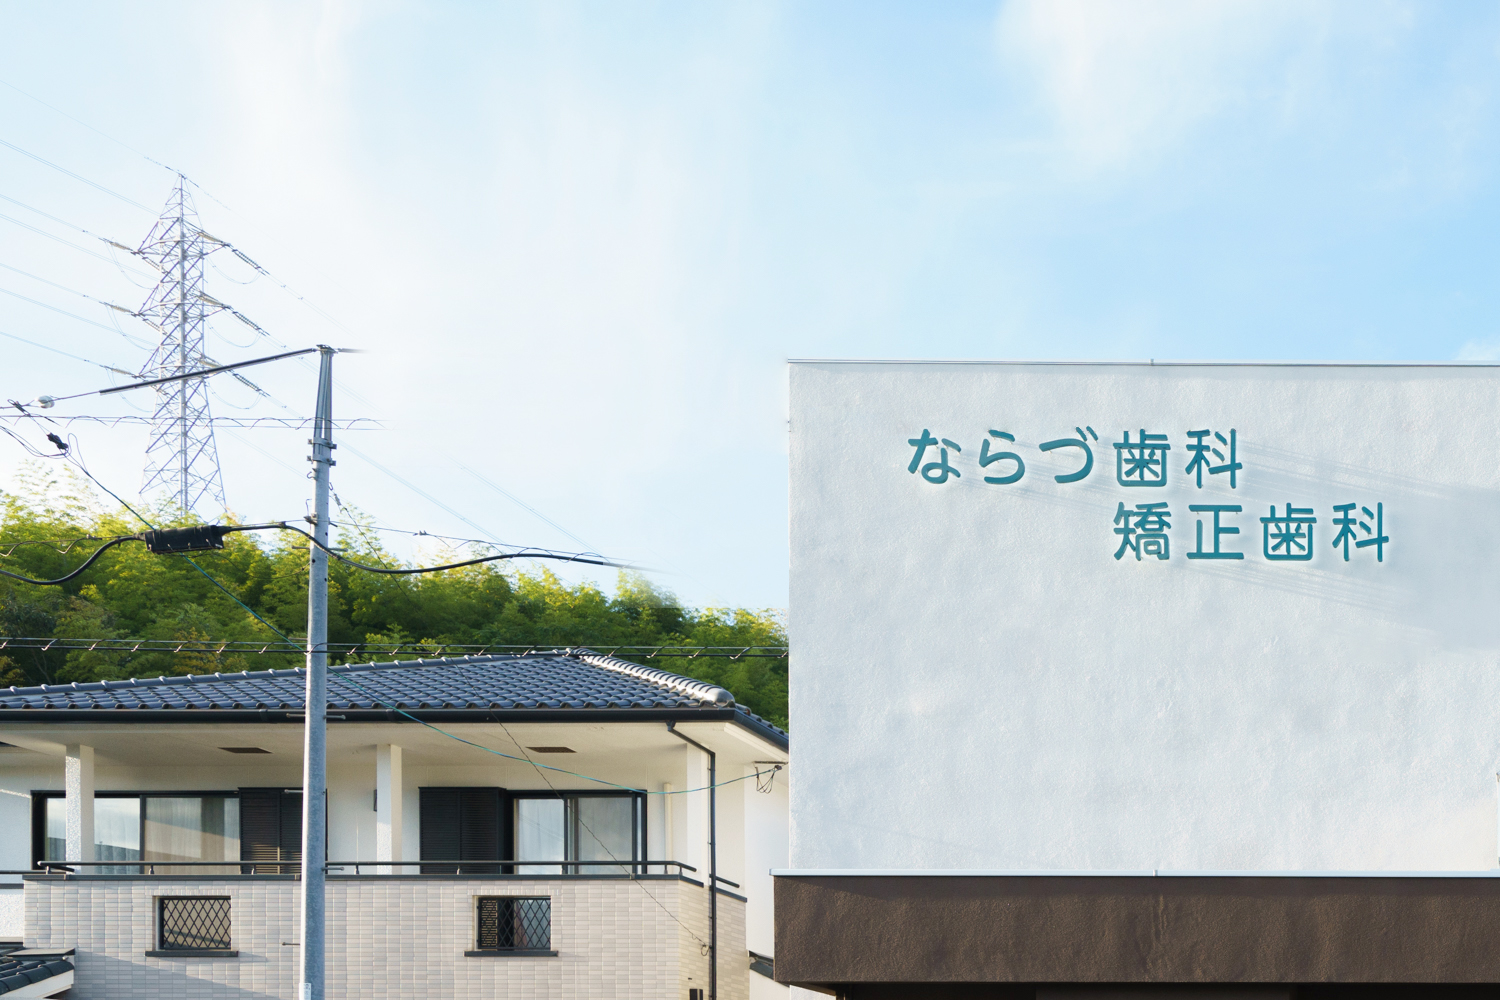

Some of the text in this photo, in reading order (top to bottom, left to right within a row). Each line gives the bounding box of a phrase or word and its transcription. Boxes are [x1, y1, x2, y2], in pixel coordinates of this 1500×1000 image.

[907, 426, 1243, 488] ならづ歯科
[1113, 501, 1390, 562] 矯正歯科
